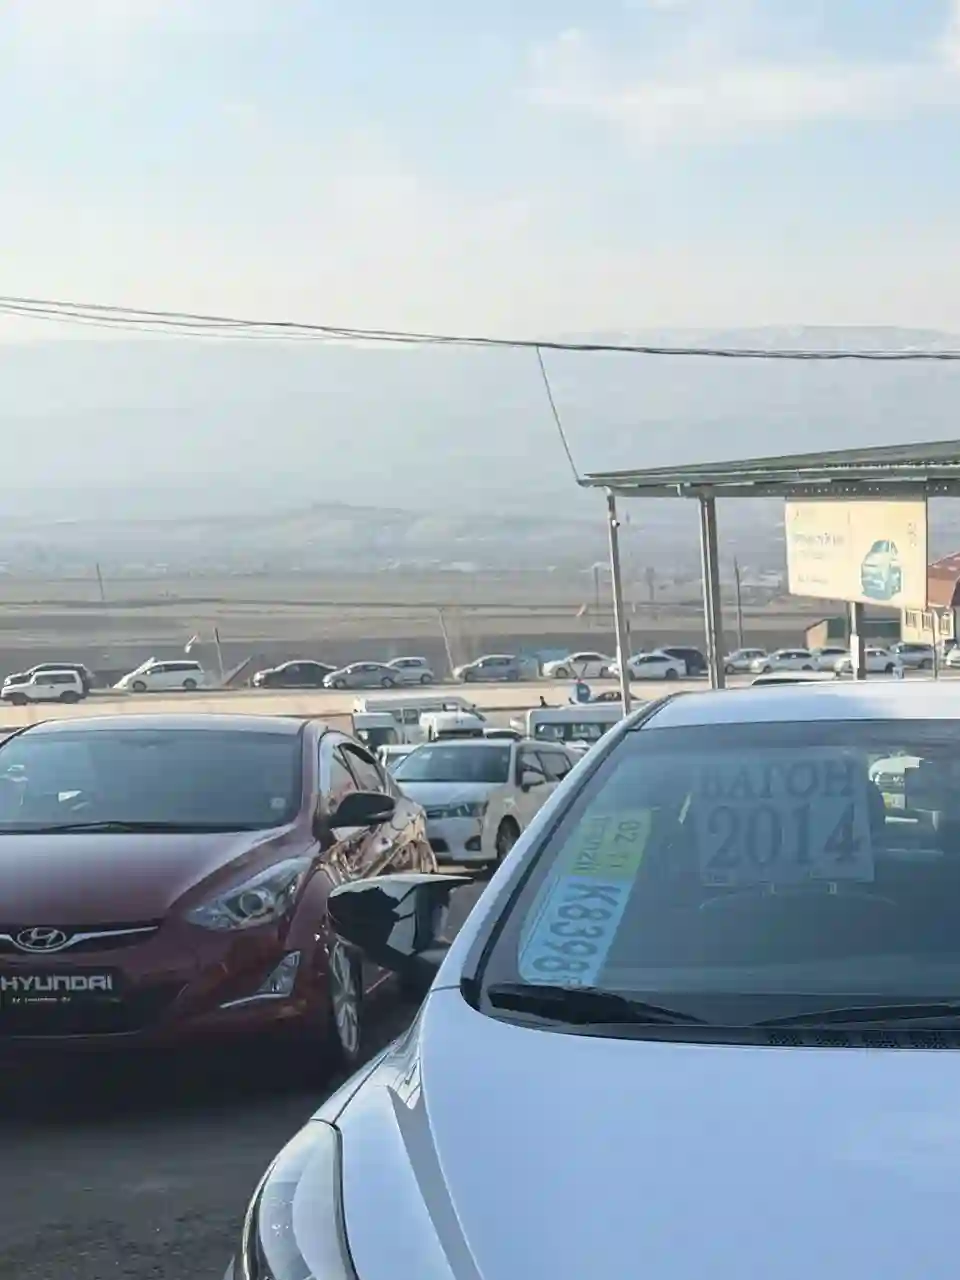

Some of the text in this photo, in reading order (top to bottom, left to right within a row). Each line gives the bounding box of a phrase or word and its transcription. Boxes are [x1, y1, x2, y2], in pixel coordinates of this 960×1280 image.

[704, 801, 867, 869] 2014
[532, 882, 622, 975] K8398
[0, 974, 113, 991] HYUNDAI
